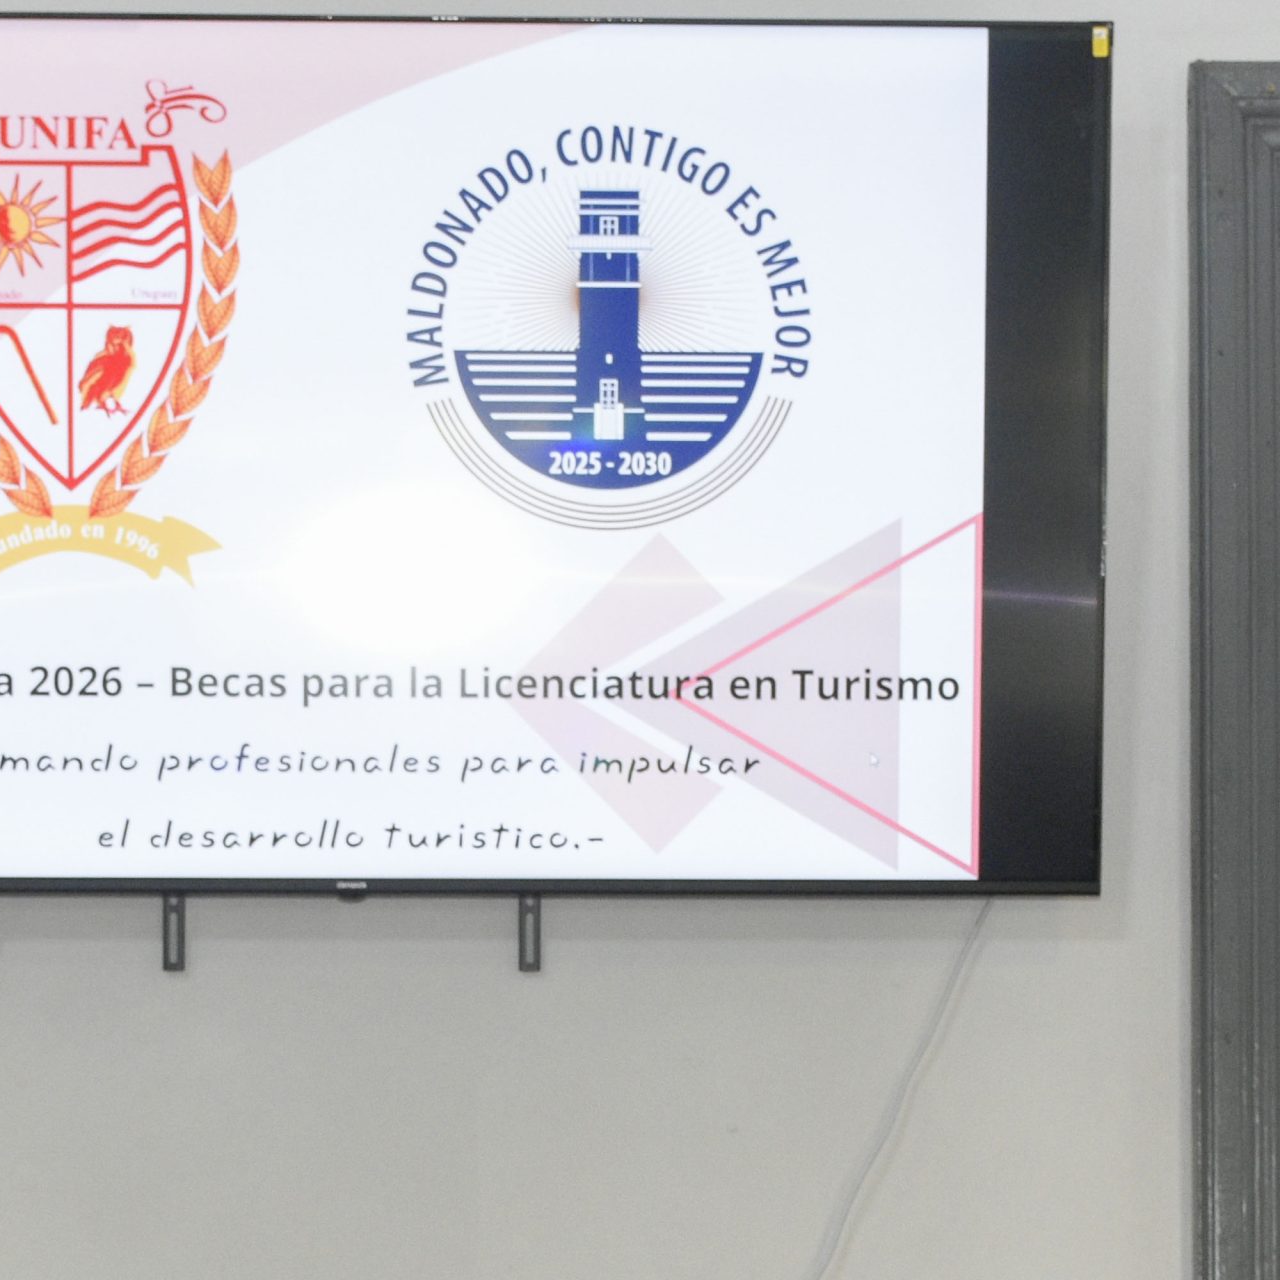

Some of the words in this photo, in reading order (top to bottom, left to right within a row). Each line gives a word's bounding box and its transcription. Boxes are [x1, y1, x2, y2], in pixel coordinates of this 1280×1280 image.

[405, 146, 549, 388] MALDONADO,
[556, 125, 732, 196] CONTIGO
[726, 186, 776, 238] ES
[757, 239, 812, 380] MEJOR
[548, 452, 602, 476] 2025
[617, 452, 673, 476] 2030
[81, 523, 105, 539] en
[114, 526, 161, 560] 1996
[30, 666, 122, 697] 2026
[170, 667, 287, 697] Becas
[302, 674, 394, 708] para
[409, 667, 442, 698] la
[459, 667, 714, 700] Licenciatura
[729, 676, 777, 700] en
[791, 668, 960, 701] Turismo
[157, 743, 441, 781] profesionales
[460, 756, 560, 782] para
[579, 744, 762, 783] impulsar
[98, 819, 131, 847] el
[150, 819, 364, 849] desarrollo
